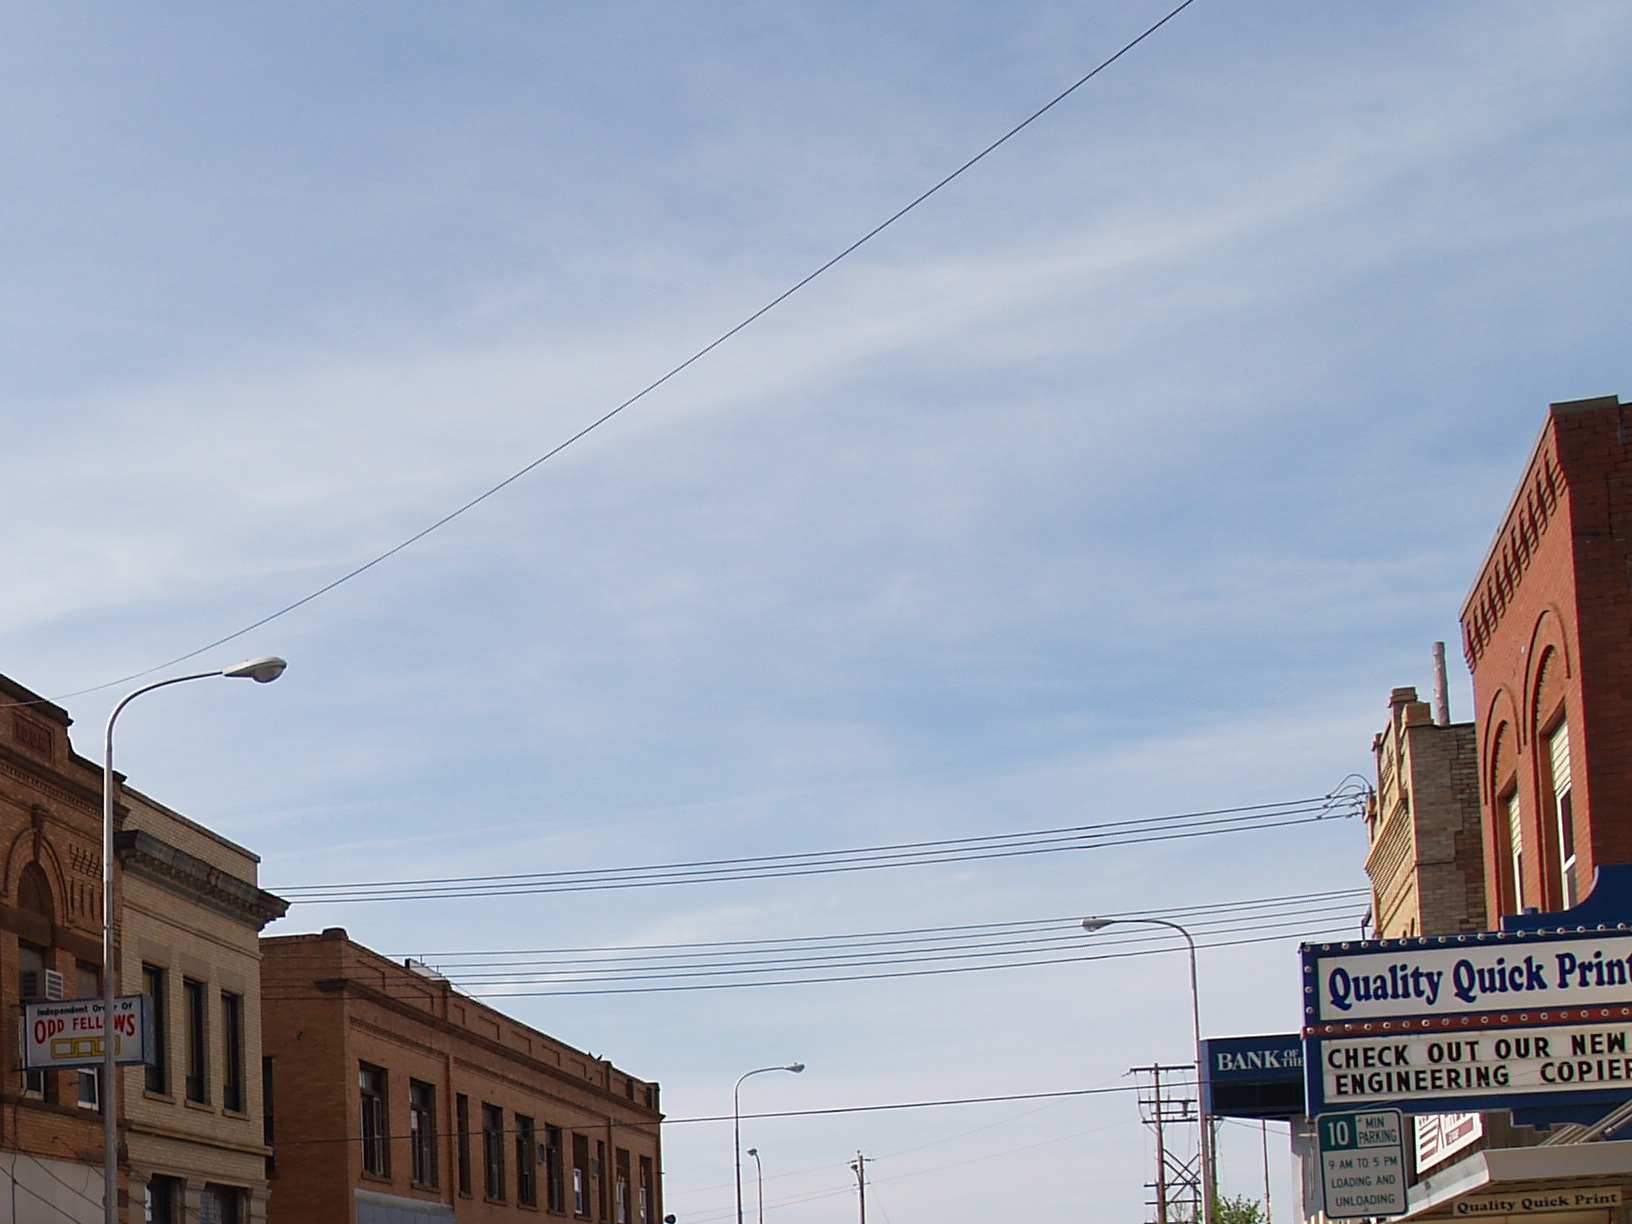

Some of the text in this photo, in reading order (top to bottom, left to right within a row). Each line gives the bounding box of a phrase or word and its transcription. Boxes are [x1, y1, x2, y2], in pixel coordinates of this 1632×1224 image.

[1328, 962, 1442, 1011] Quality
[1452, 954, 1548, 1004] Quick
[36, 1006, 88, 1017] Independent
[34, 1014, 135, 1044] ODD FELLWS
[1282, 1049, 1298, 1058] OF
[1327, 1032, 1624, 1070] CHECK OUT OUR NEW
[1216, 1050, 1281, 1072] BANK
[1334, 1064, 1507, 1096] ENGINEERING
[1365, 1117, 1384, 1129] MIN
[1327, 1121, 1349, 1147] 10
[1358, 1129, 1397, 1145] PARKING
[1328, 1156, 1397, 1170] 9 AM TO 5 PM
[1332, 1175, 1395, 1189] LOADING AND
[1335, 1194, 1395, 1207] UNLOADING
[1457, 1193, 1617, 1215] Quality Quick Print
